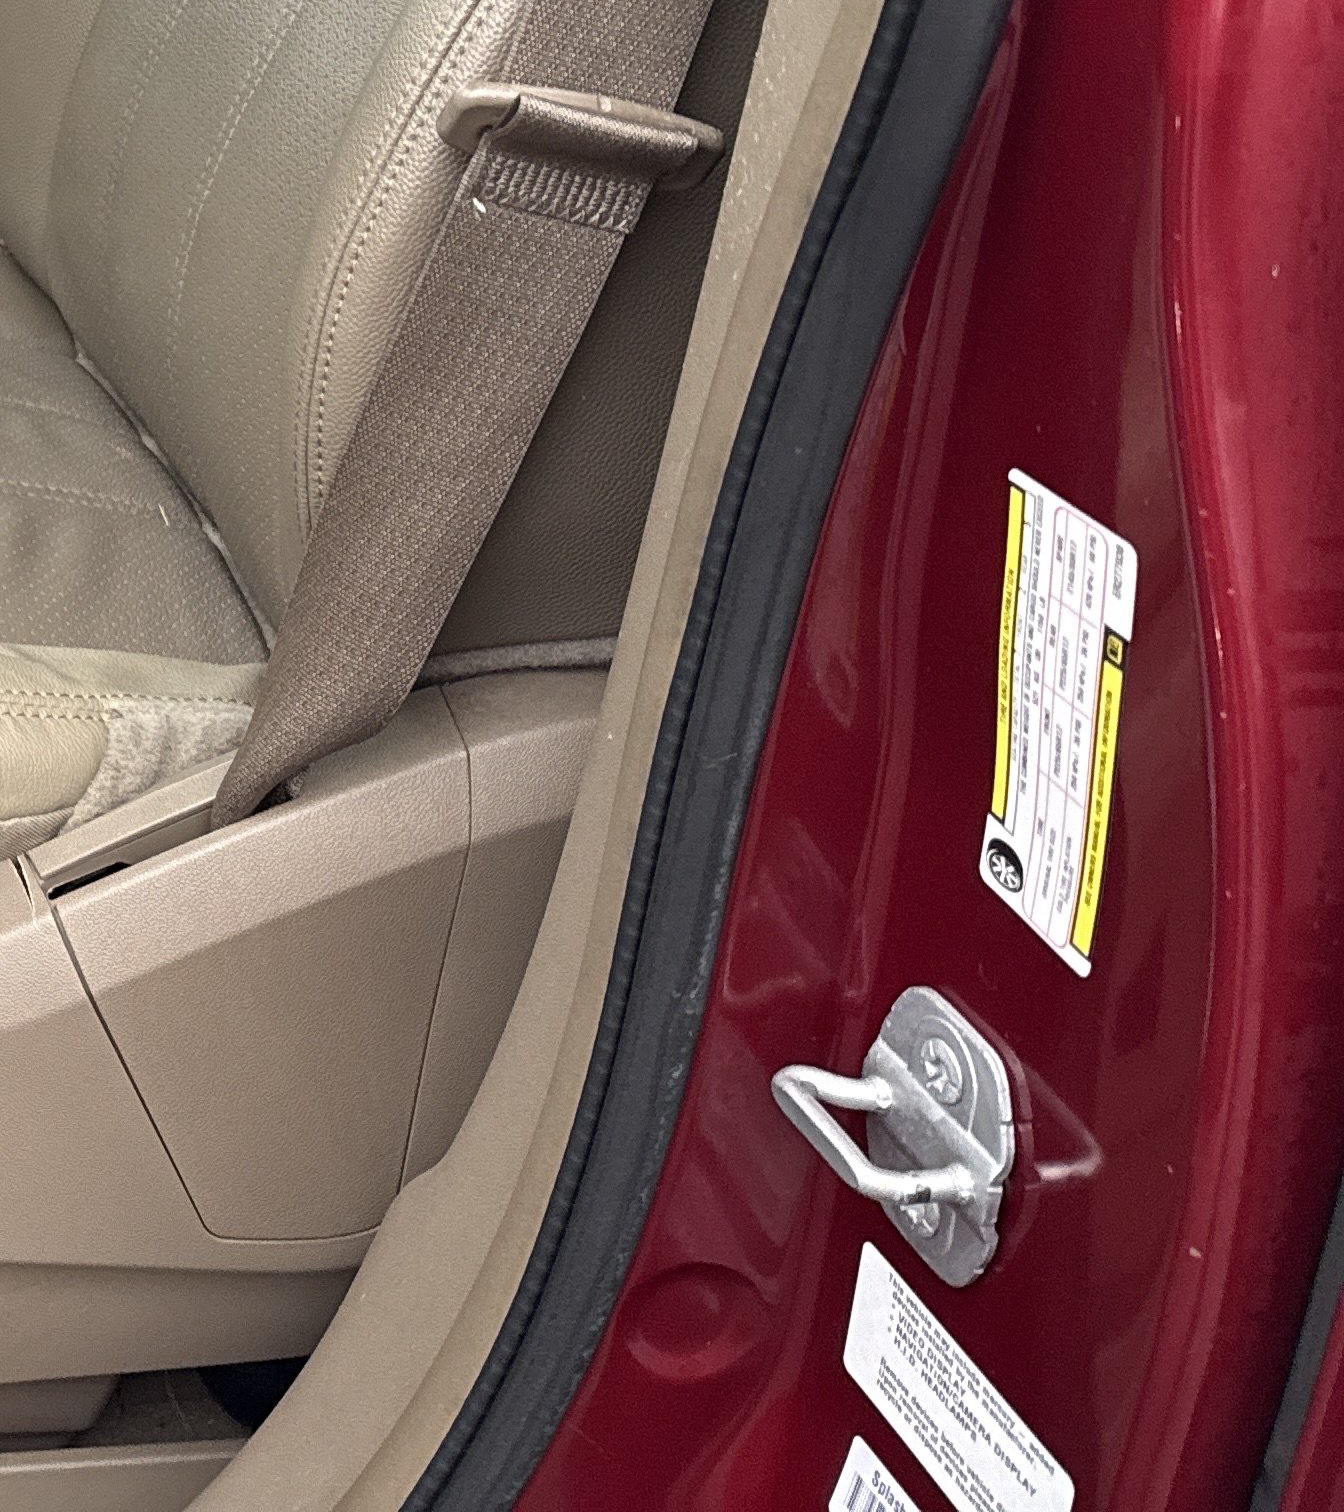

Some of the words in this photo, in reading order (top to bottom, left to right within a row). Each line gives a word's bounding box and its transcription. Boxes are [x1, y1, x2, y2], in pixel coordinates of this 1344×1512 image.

[899, 1312, 924, 1348] VIDEO
[927, 1347, 966, 1396] DISPLAY
[994, 1443, 1036, 1497] DISPLAY
